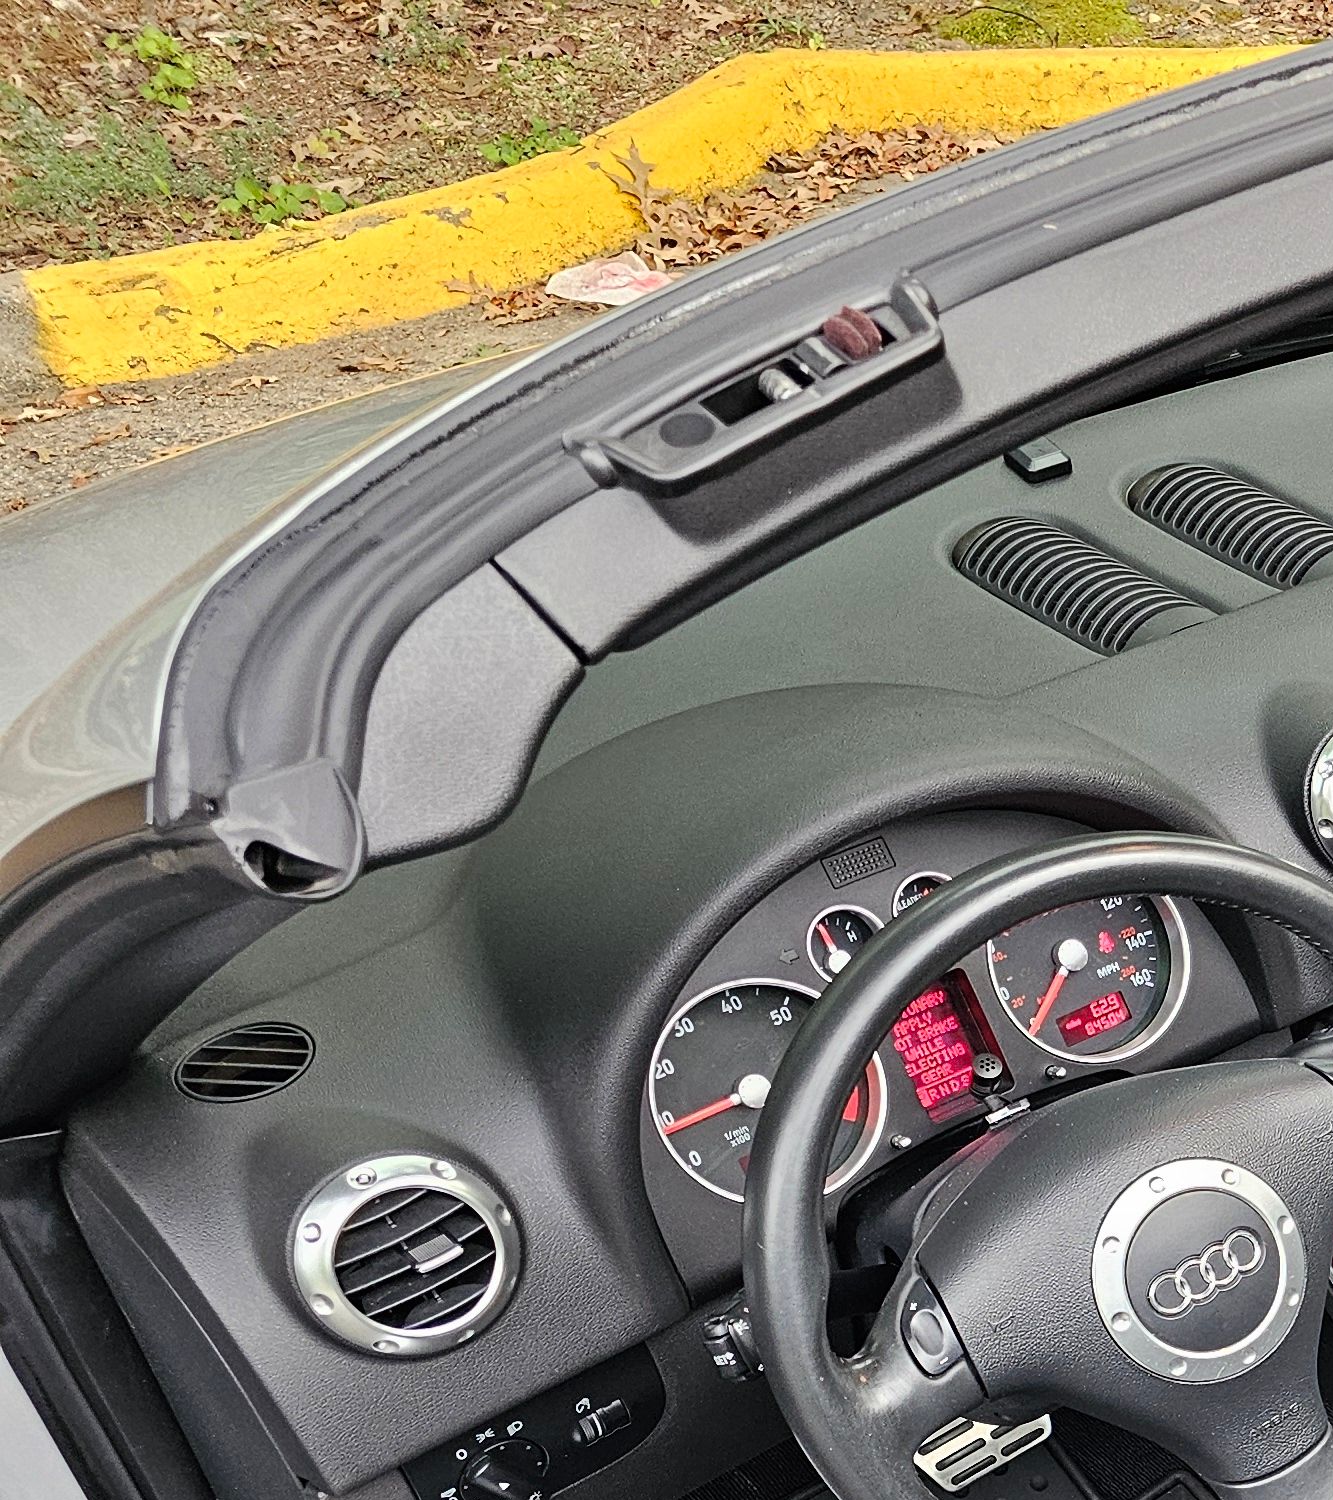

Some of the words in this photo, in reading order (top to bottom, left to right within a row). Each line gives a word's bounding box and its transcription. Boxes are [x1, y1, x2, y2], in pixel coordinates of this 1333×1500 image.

[1100, 896, 1123, 911] 120
[1120, 926, 1136, 939] 220
[1125, 932, 1147, 951] 140
[1096, 961, 1120, 979] MPH
[1120, 965, 1136, 978] 260
[1130, 968, 1152, 987] 160
[721, 995, 743, 1014] 40
[769, 1006, 793, 1026] 50
[893, 1010, 932, 1038] APPLY
[674, 1017, 695, 1038] 30
[916, 1015, 958, 1042] BRAKE
[904, 1035, 946, 1061] WHILE
[655, 1058, 675, 1080] 20
[904, 1042, 966, 1078] ELECTING
[920, 1063, 954, 1085] GEAR
[724, 1125, 750, 1141] 1/min
[729, 1132, 751, 1148] x100
[688, 1150, 702, 1167] 0
